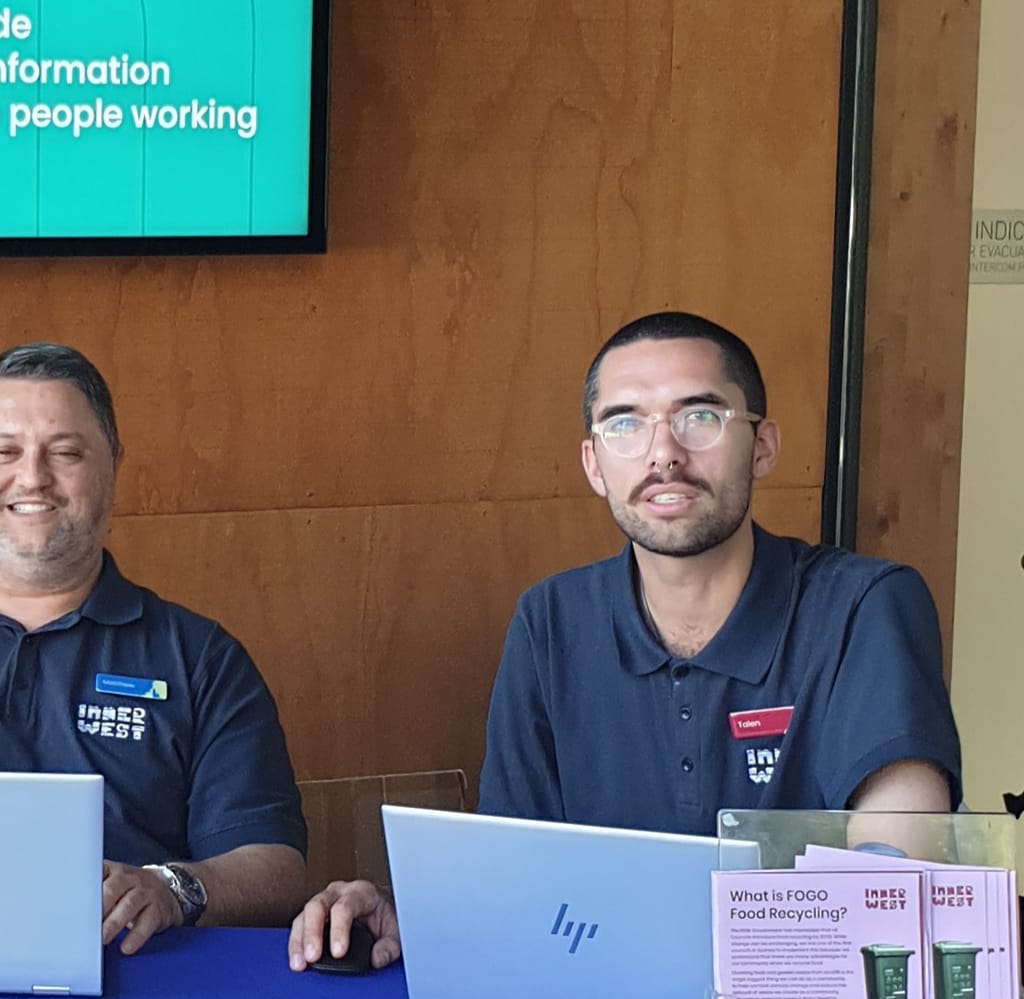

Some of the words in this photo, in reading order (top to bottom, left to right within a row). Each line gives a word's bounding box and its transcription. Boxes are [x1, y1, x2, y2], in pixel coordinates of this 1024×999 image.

[9, 99, 123, 138] people
[130, 99, 258, 138] working
[975, 220, 1024, 241] INDIC
[78, 704, 146, 724] INNER
[77, 720, 145, 740] WEST
[730, 890, 769, 902] What
[773, 889, 784, 902] is
[787, 890, 829, 902] FOGO
[865, 888, 906, 899] INNER
[931, 885, 974, 896] INNER
[865, 900, 907, 910] WEST
[932, 897, 975, 907] WEST
[730, 907, 766, 920] Food
[769, 906, 848, 923] Recycling?
